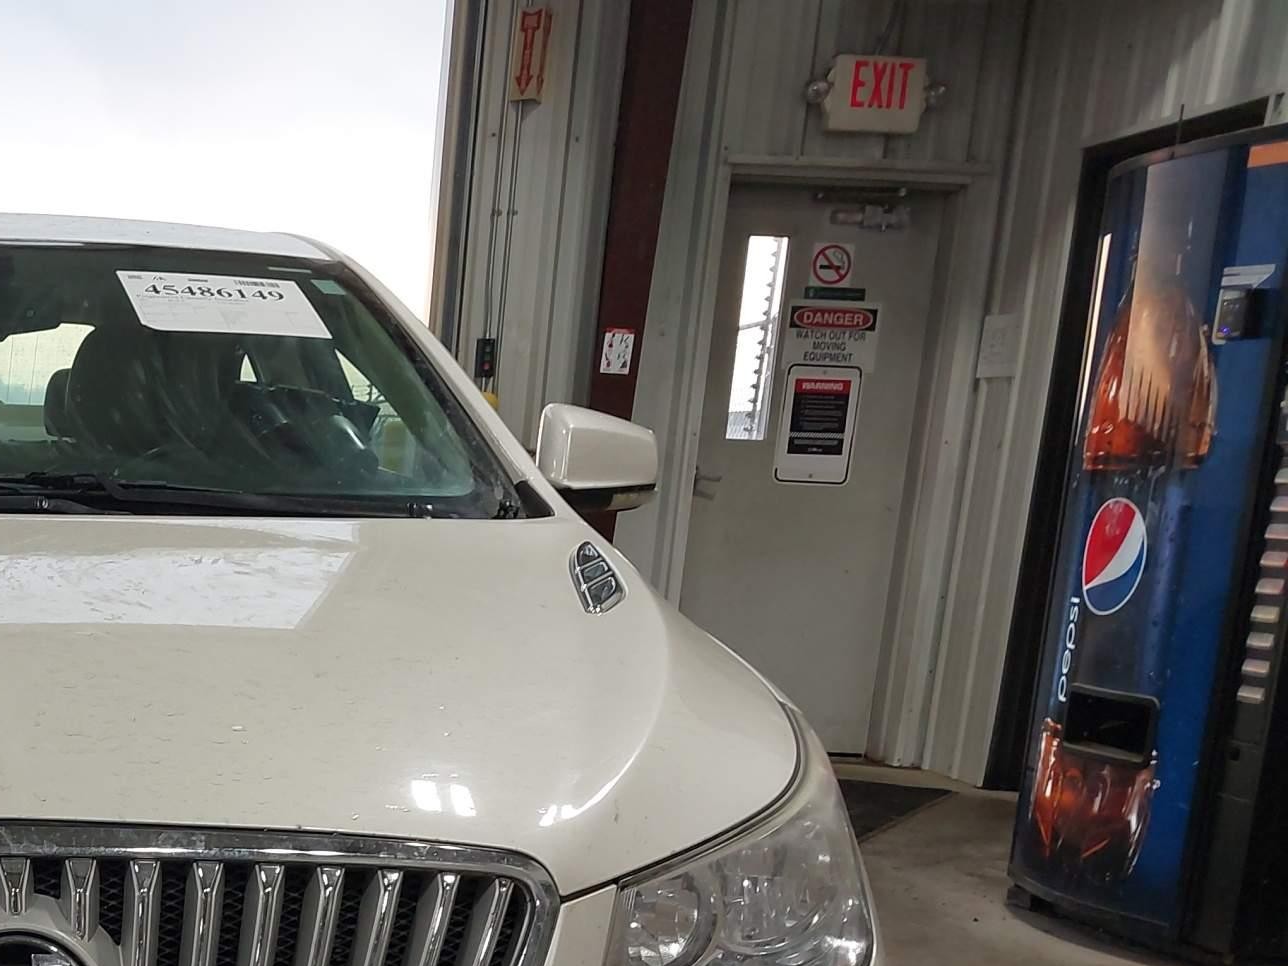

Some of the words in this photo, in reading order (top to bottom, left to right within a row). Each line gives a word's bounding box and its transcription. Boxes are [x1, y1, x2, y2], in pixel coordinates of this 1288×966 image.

[849, 60, 915, 110] EXIT
[143, 283, 285, 301] 45486149
[803, 311, 864, 326] DANGER
[796, 329, 827, 340] WATCH
[829, 330, 847, 341] OUT
[848, 331, 866, 342] FOR
[813, 341, 847, 351] MOVING
[803, 351, 854, 362] EQUIPMENT
[802, 382, 843, 391] WARNING
[1058, 597, 1080, 702] pepsi
